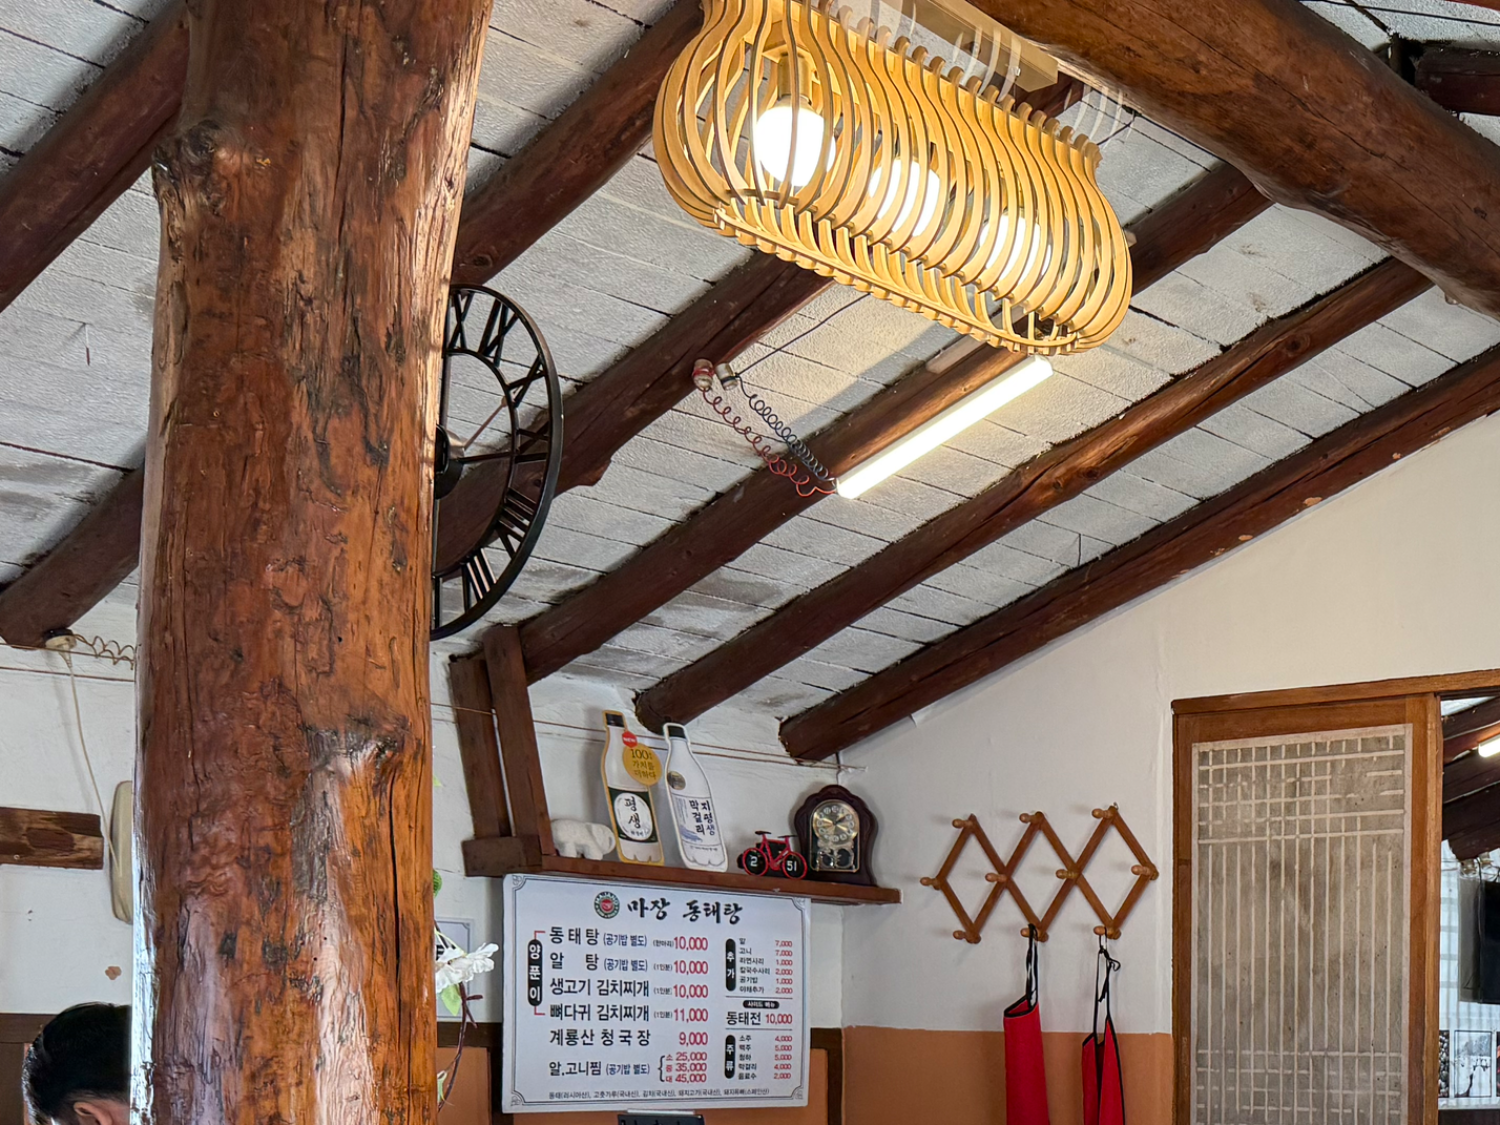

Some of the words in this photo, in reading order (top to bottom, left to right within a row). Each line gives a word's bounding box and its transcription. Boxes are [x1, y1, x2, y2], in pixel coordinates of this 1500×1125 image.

[624, 796, 641, 829] 평생
[689, 800, 705, 835] 막걸리
[701, 800, 715, 835] 지평생
[627, 897, 671, 920] 마장
[683, 899, 743, 925] 동태탕
[673, 936, 708, 950] 10,000
[529, 944, 541, 1001] 양푼이
[673, 960, 709, 975] 10,000
[550, 978, 591, 996] 생고기
[597, 979, 649, 997] 김치찌개
[673, 984, 708, 999] 10,000
[550, 1003, 591, 1021] 뼈다귀
[597, 1003, 649, 1021] 김치찌개
[673, 1008, 708, 1023] 11,000
[726, 1011, 761, 1026] 동태전
[766, 1013, 793, 1025] 10,000
[550, 1029, 594, 1046] 계룡산
[679, 1031, 708, 1047] 9,000
[675, 1052, 707, 1063] 25,000
[675, 1063, 707, 1073] 35,000
[675, 1073, 707, 1084] 45,000
